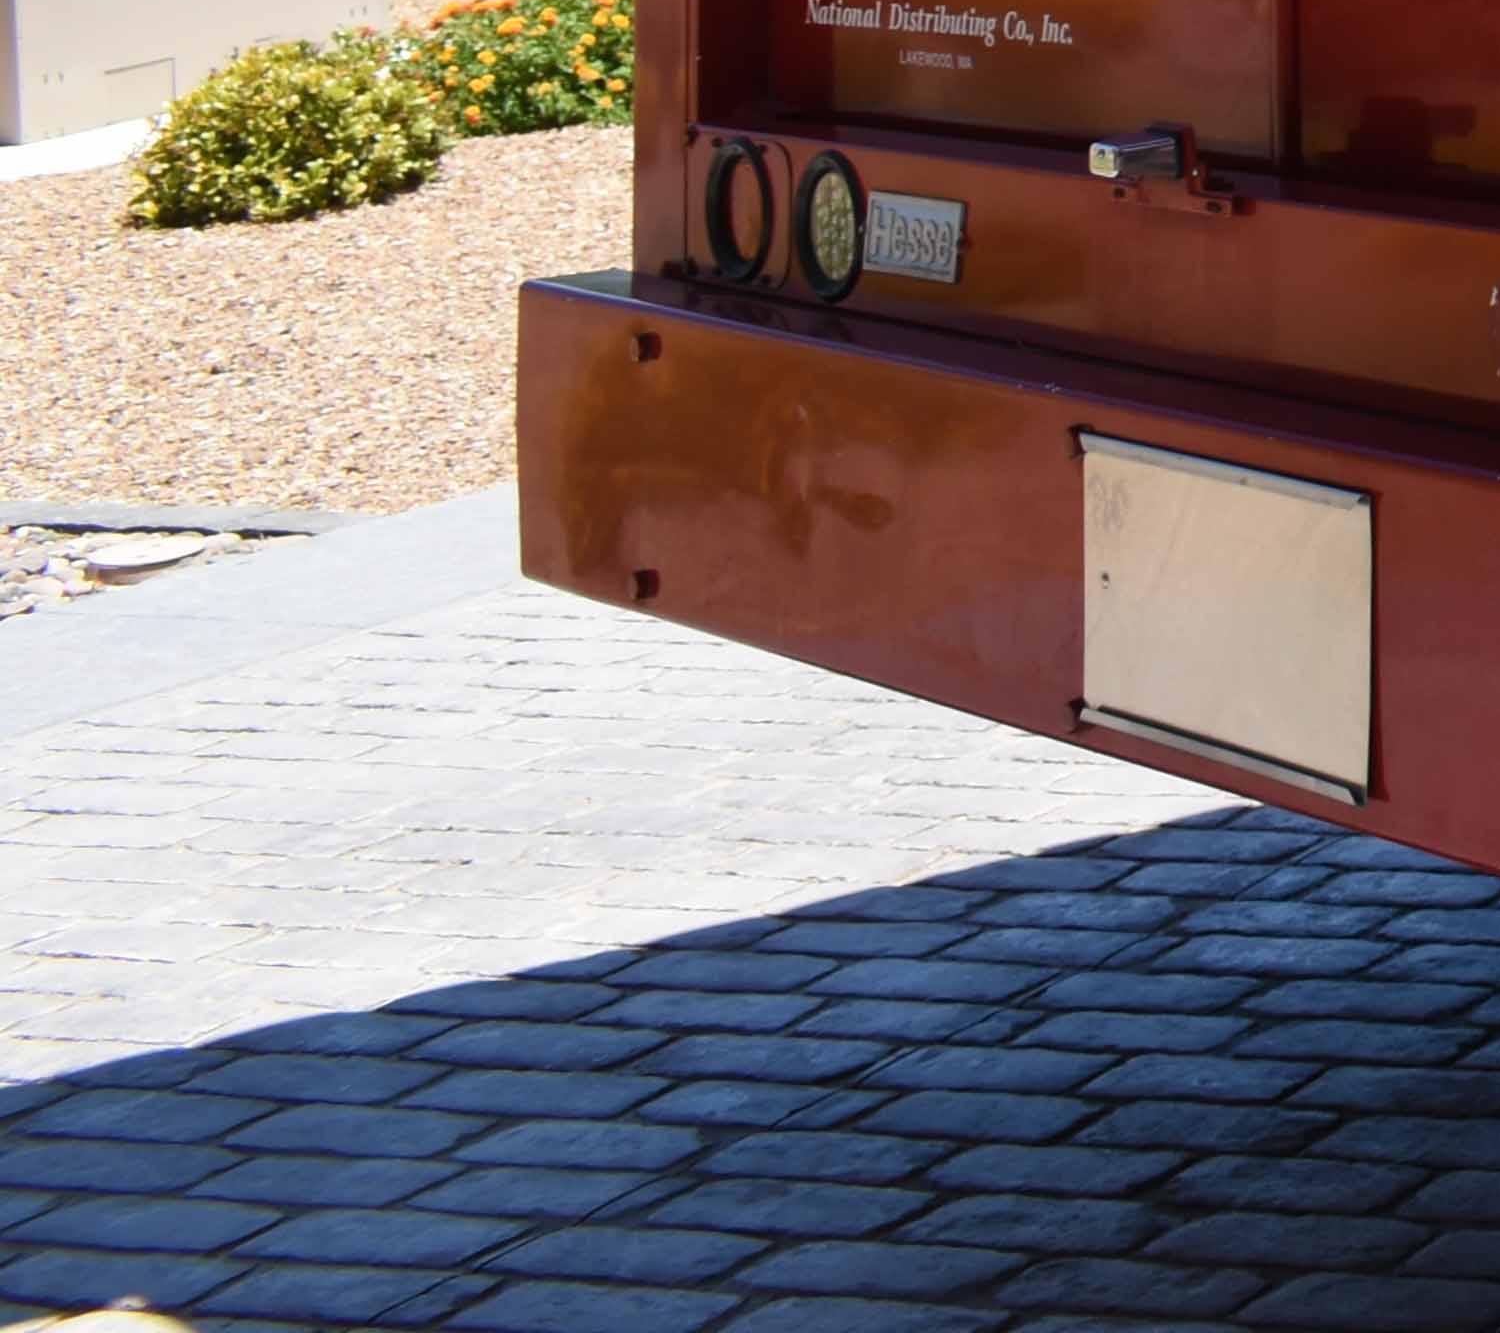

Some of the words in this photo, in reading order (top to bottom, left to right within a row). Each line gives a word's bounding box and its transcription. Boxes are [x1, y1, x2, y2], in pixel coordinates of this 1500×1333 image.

[889, 2, 996, 47] Distributing
[1040, 14, 1073, 45] Inc.
[867, 203, 953, 267] Hesse
